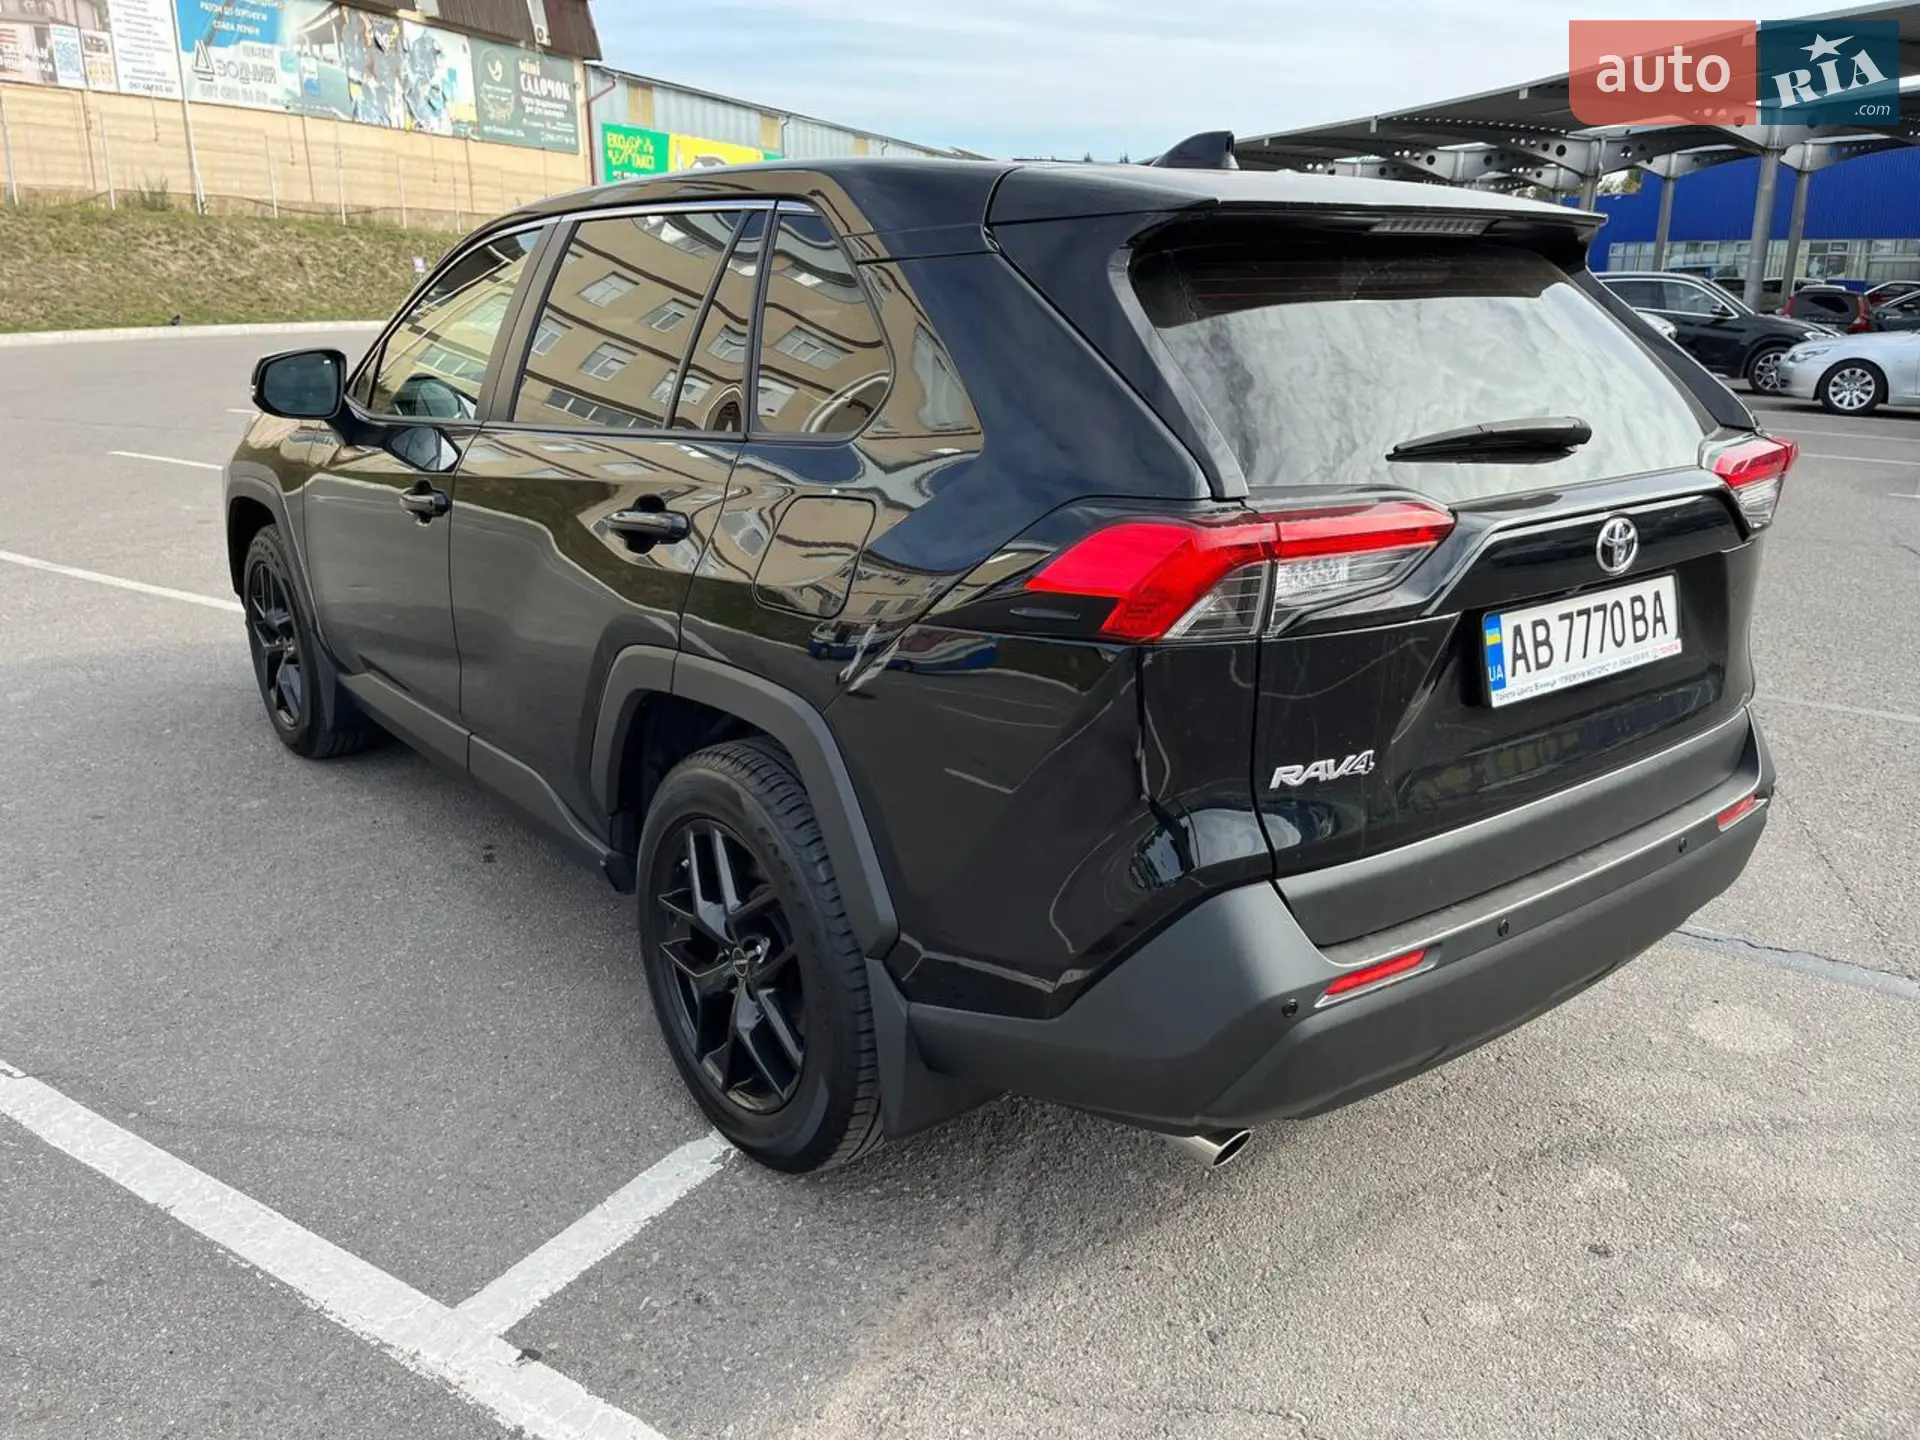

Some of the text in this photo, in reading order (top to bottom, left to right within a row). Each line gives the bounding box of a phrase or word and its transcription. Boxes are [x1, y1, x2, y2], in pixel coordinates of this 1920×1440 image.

[520, 73, 571, 101] САДОЧОК
[1488, 664, 1505, 682] UA
[1269, 749, 1375, 789] RAV4
